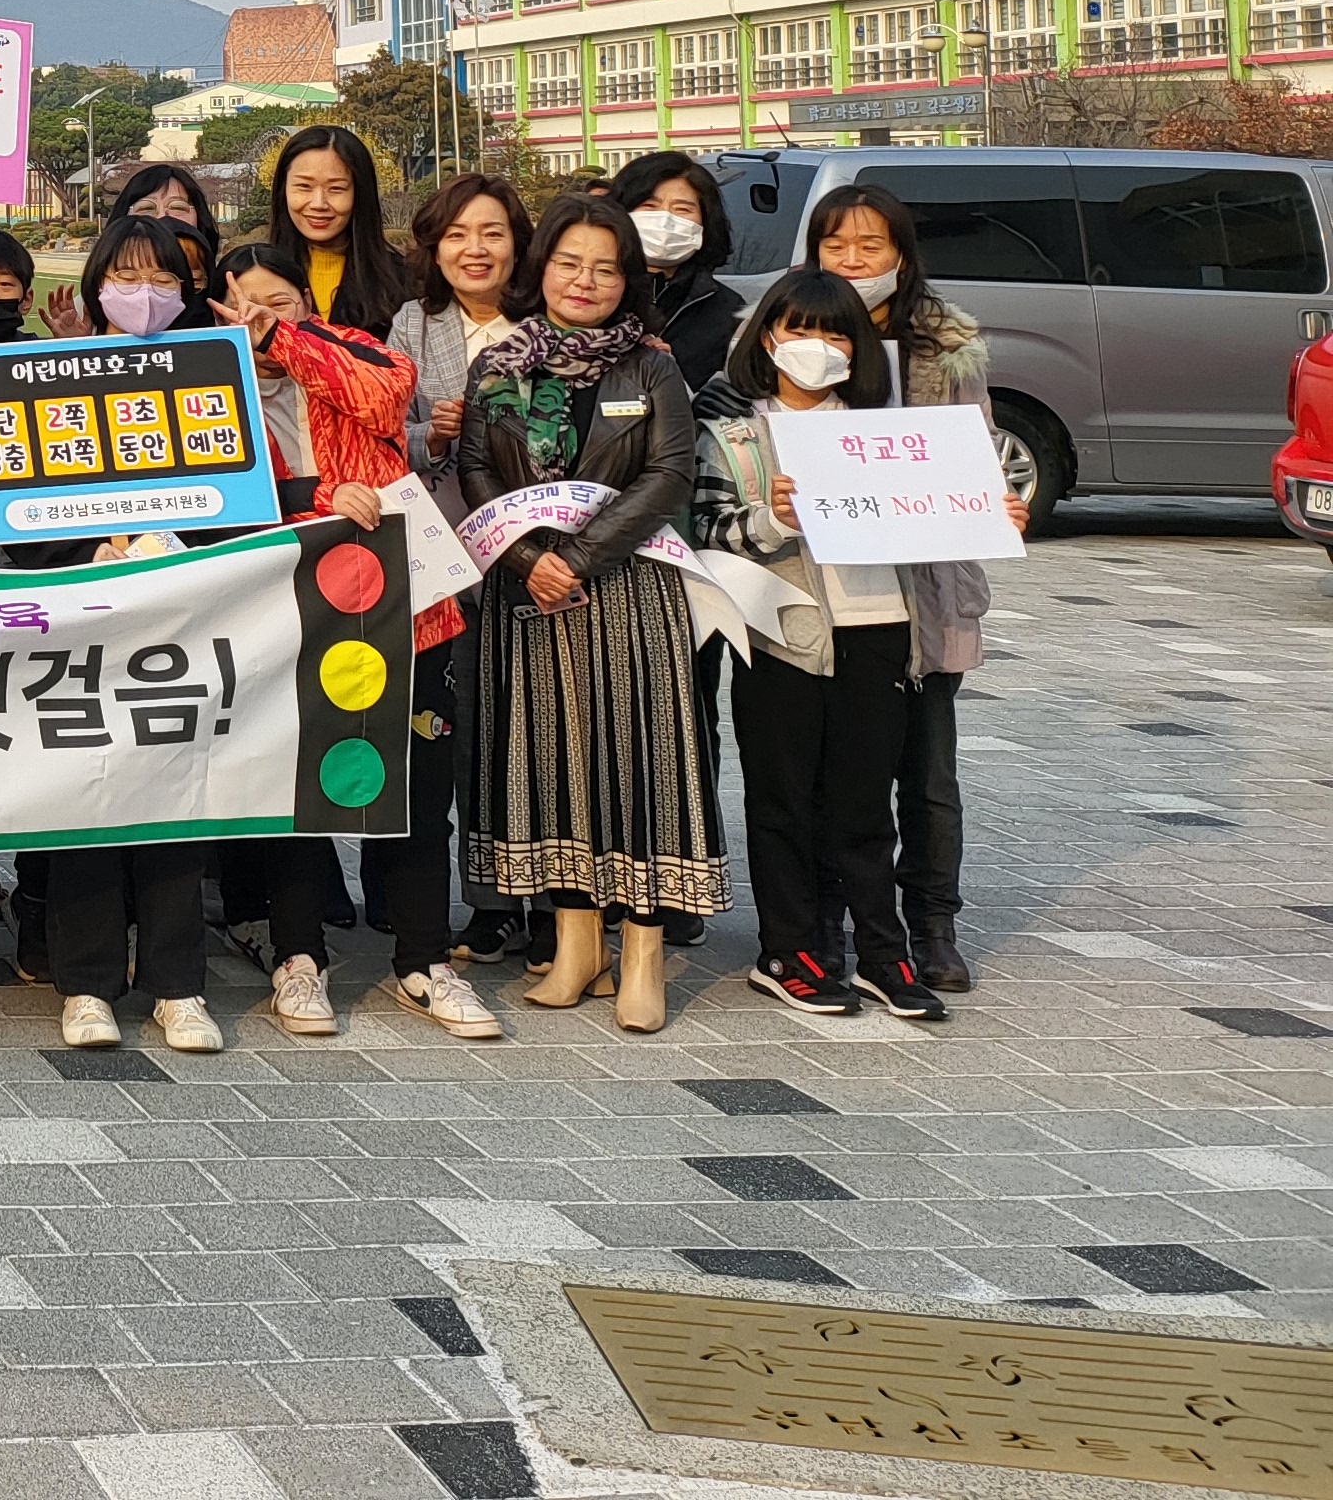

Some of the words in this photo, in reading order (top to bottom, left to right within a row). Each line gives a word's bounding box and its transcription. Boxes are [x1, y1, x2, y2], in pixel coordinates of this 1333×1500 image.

[12, 350, 174, 384] 어린이보호구역
[46, 403, 87, 431] 2쪽
[116, 398, 156, 423] 3초
[185, 393, 227, 418] 4고
[49, 438, 95, 466] 저쪽
[118, 433, 166, 463] 동안
[187, 427, 237, 456] 예방
[837, 433, 931, 464] 학교앞
[46, 494, 208, 520] 경상남도의령교육지원청
[889, 494, 937, 515] No!
[946, 492, 991, 513] No!
